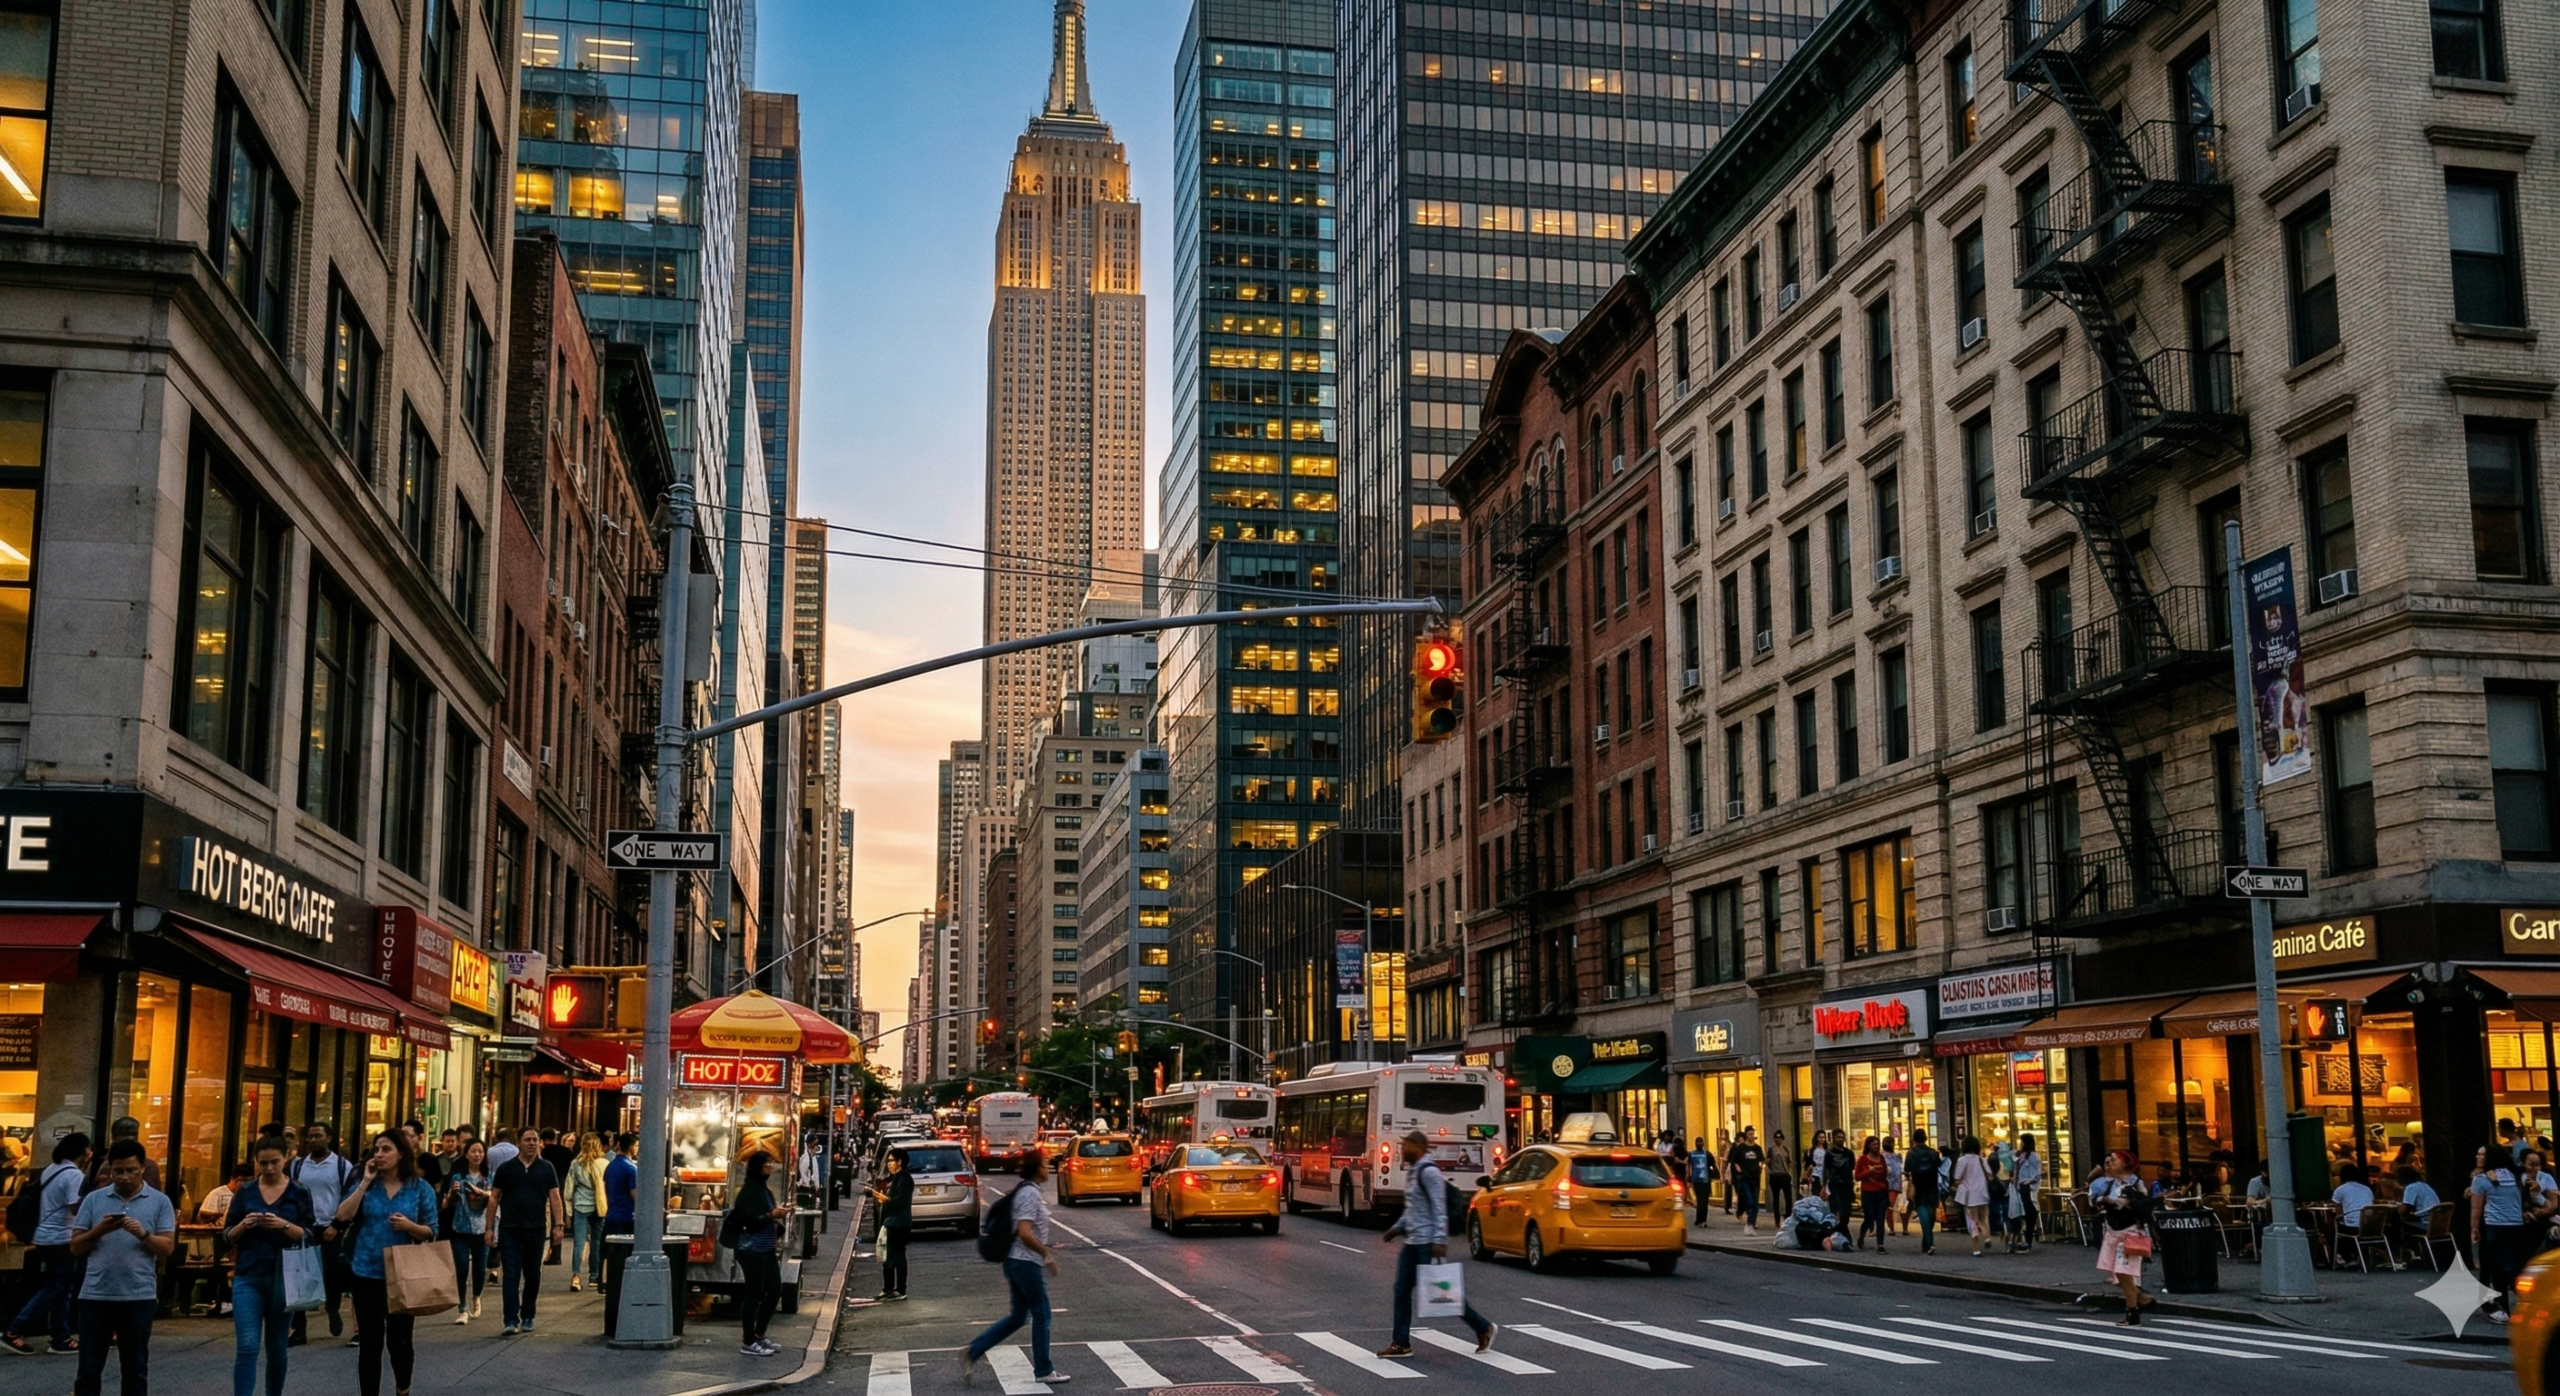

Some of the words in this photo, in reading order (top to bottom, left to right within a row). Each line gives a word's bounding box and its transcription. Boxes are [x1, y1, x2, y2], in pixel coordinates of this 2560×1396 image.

[0, 816, 51, 870] E
[622, 843, 656, 858] ONE
[671, 844, 706, 858] WAY
[191, 836, 237, 905] HOT
[239, 857, 287, 925] BERG
[289, 881, 336, 944] CAFFE
[2238, 875, 2263, 889] ONE
[2272, 877, 2297, 889] WAY
[2272, 931, 2317, 958] anina
[2319, 920, 2366, 951] Café
[689, 1061, 734, 1081] HOT
